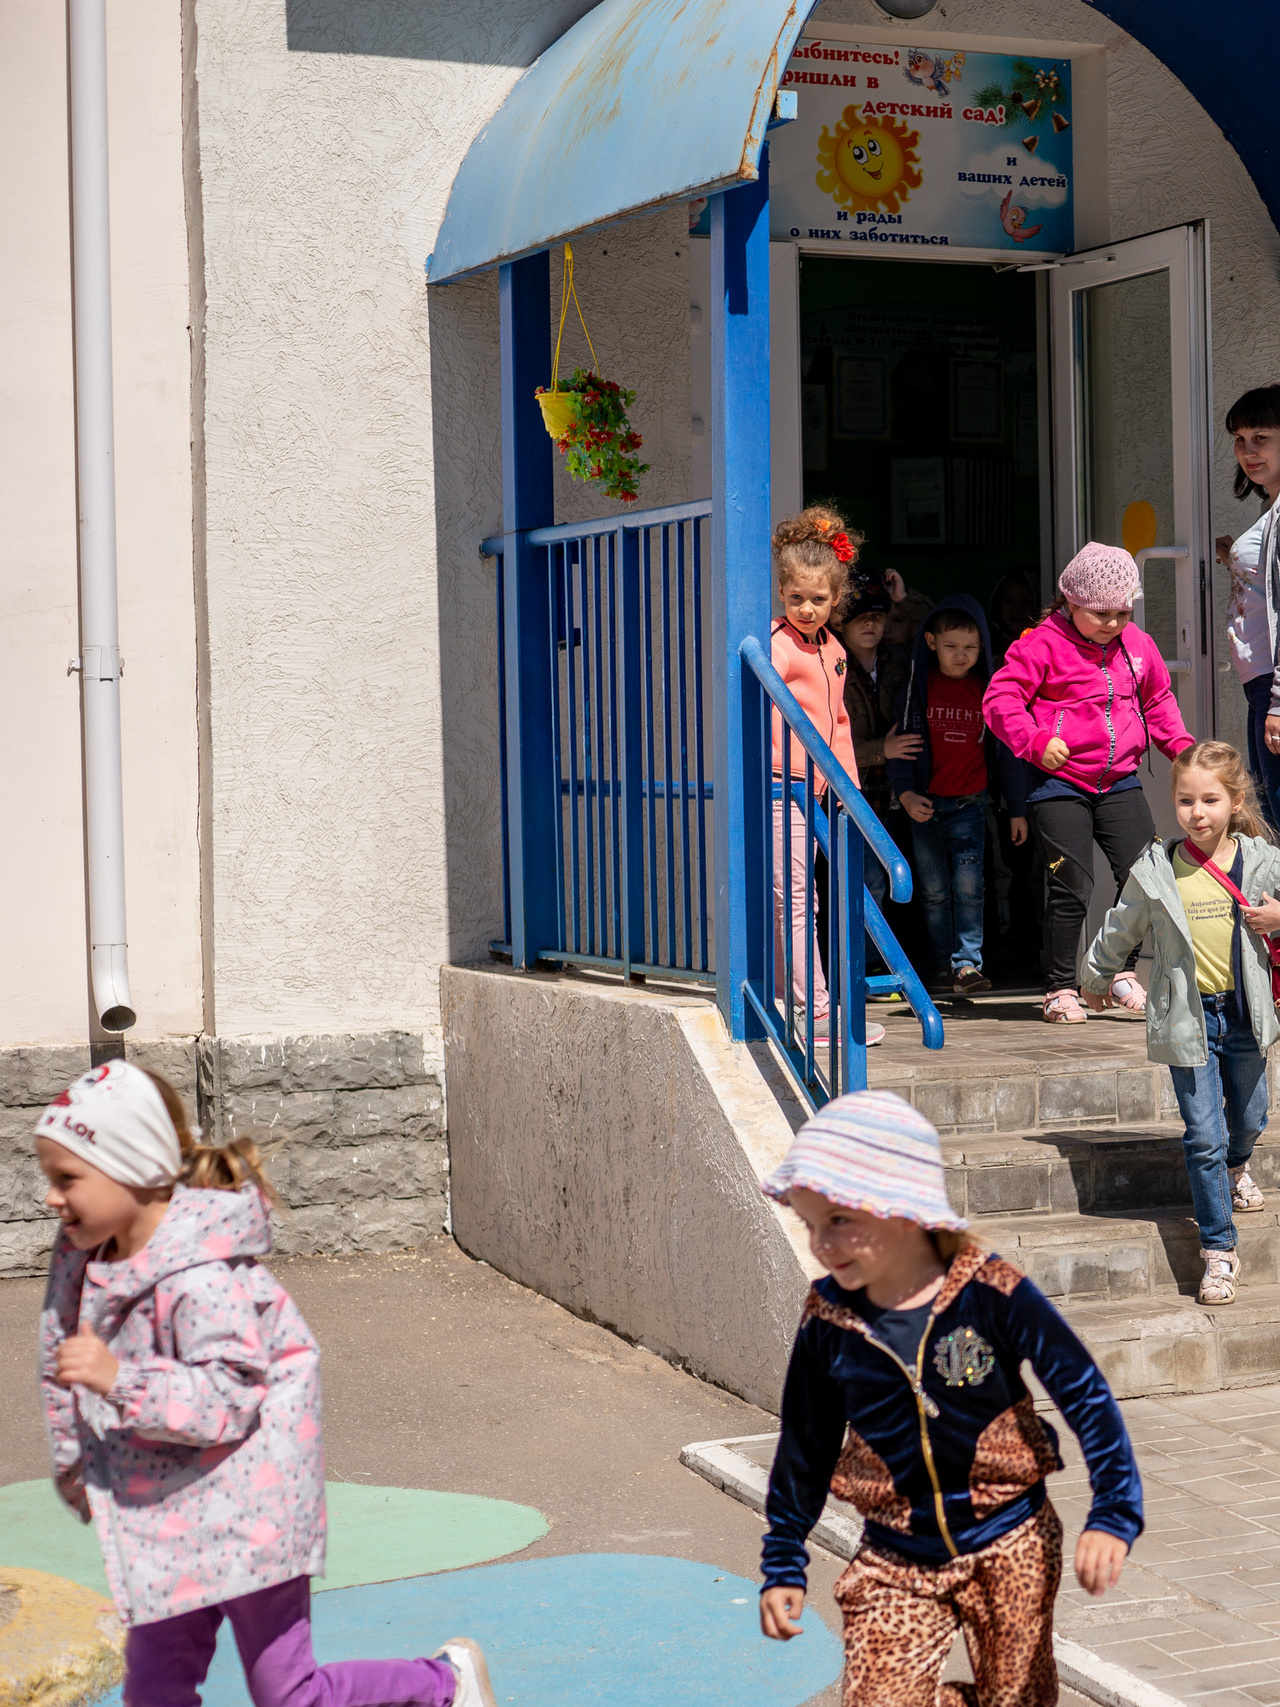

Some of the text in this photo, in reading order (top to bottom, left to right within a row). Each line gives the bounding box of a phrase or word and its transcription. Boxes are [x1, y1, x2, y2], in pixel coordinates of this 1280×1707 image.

[792, 41, 900, 66] ыбнитесь!
[781, 70, 880, 89] ришли в
[862, 100, 1006, 125] детский сад!
[1006, 155, 1018, 167] и
[957, 171, 1067, 188] ваших детей
[836, 210, 903, 225] и рады
[789, 226, 950, 246] о них заботиться
[926, 707, 982, 722] UTHENT
[63, 1115, 96, 1145] LOL
